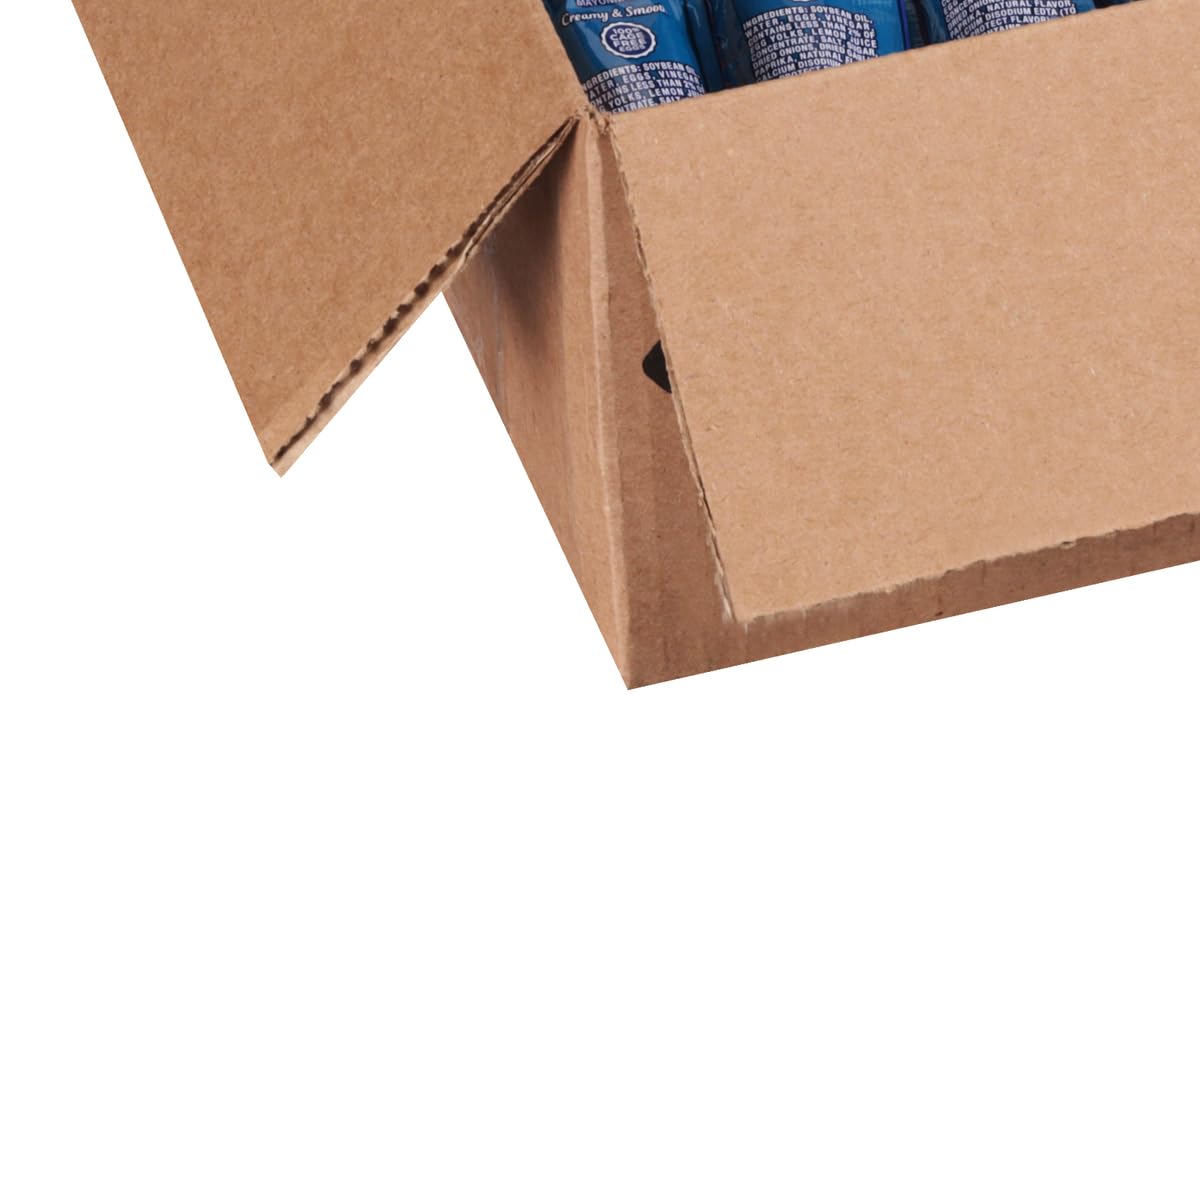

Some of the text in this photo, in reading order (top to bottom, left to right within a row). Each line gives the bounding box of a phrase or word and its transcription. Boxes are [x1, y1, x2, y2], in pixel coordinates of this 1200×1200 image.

[987, 0, 1075, 12] NATURAL FLAVOR,
[562, 11, 608, 26] Creamy
[612, 8, 623, 18] &
[743, 7, 809, 30] INGREDIENTS:
[986, 8, 1057, 20] DISODIUM EDTA
[613, 39, 647, 48] FREE
[619, 44, 646, 52] EGGS
